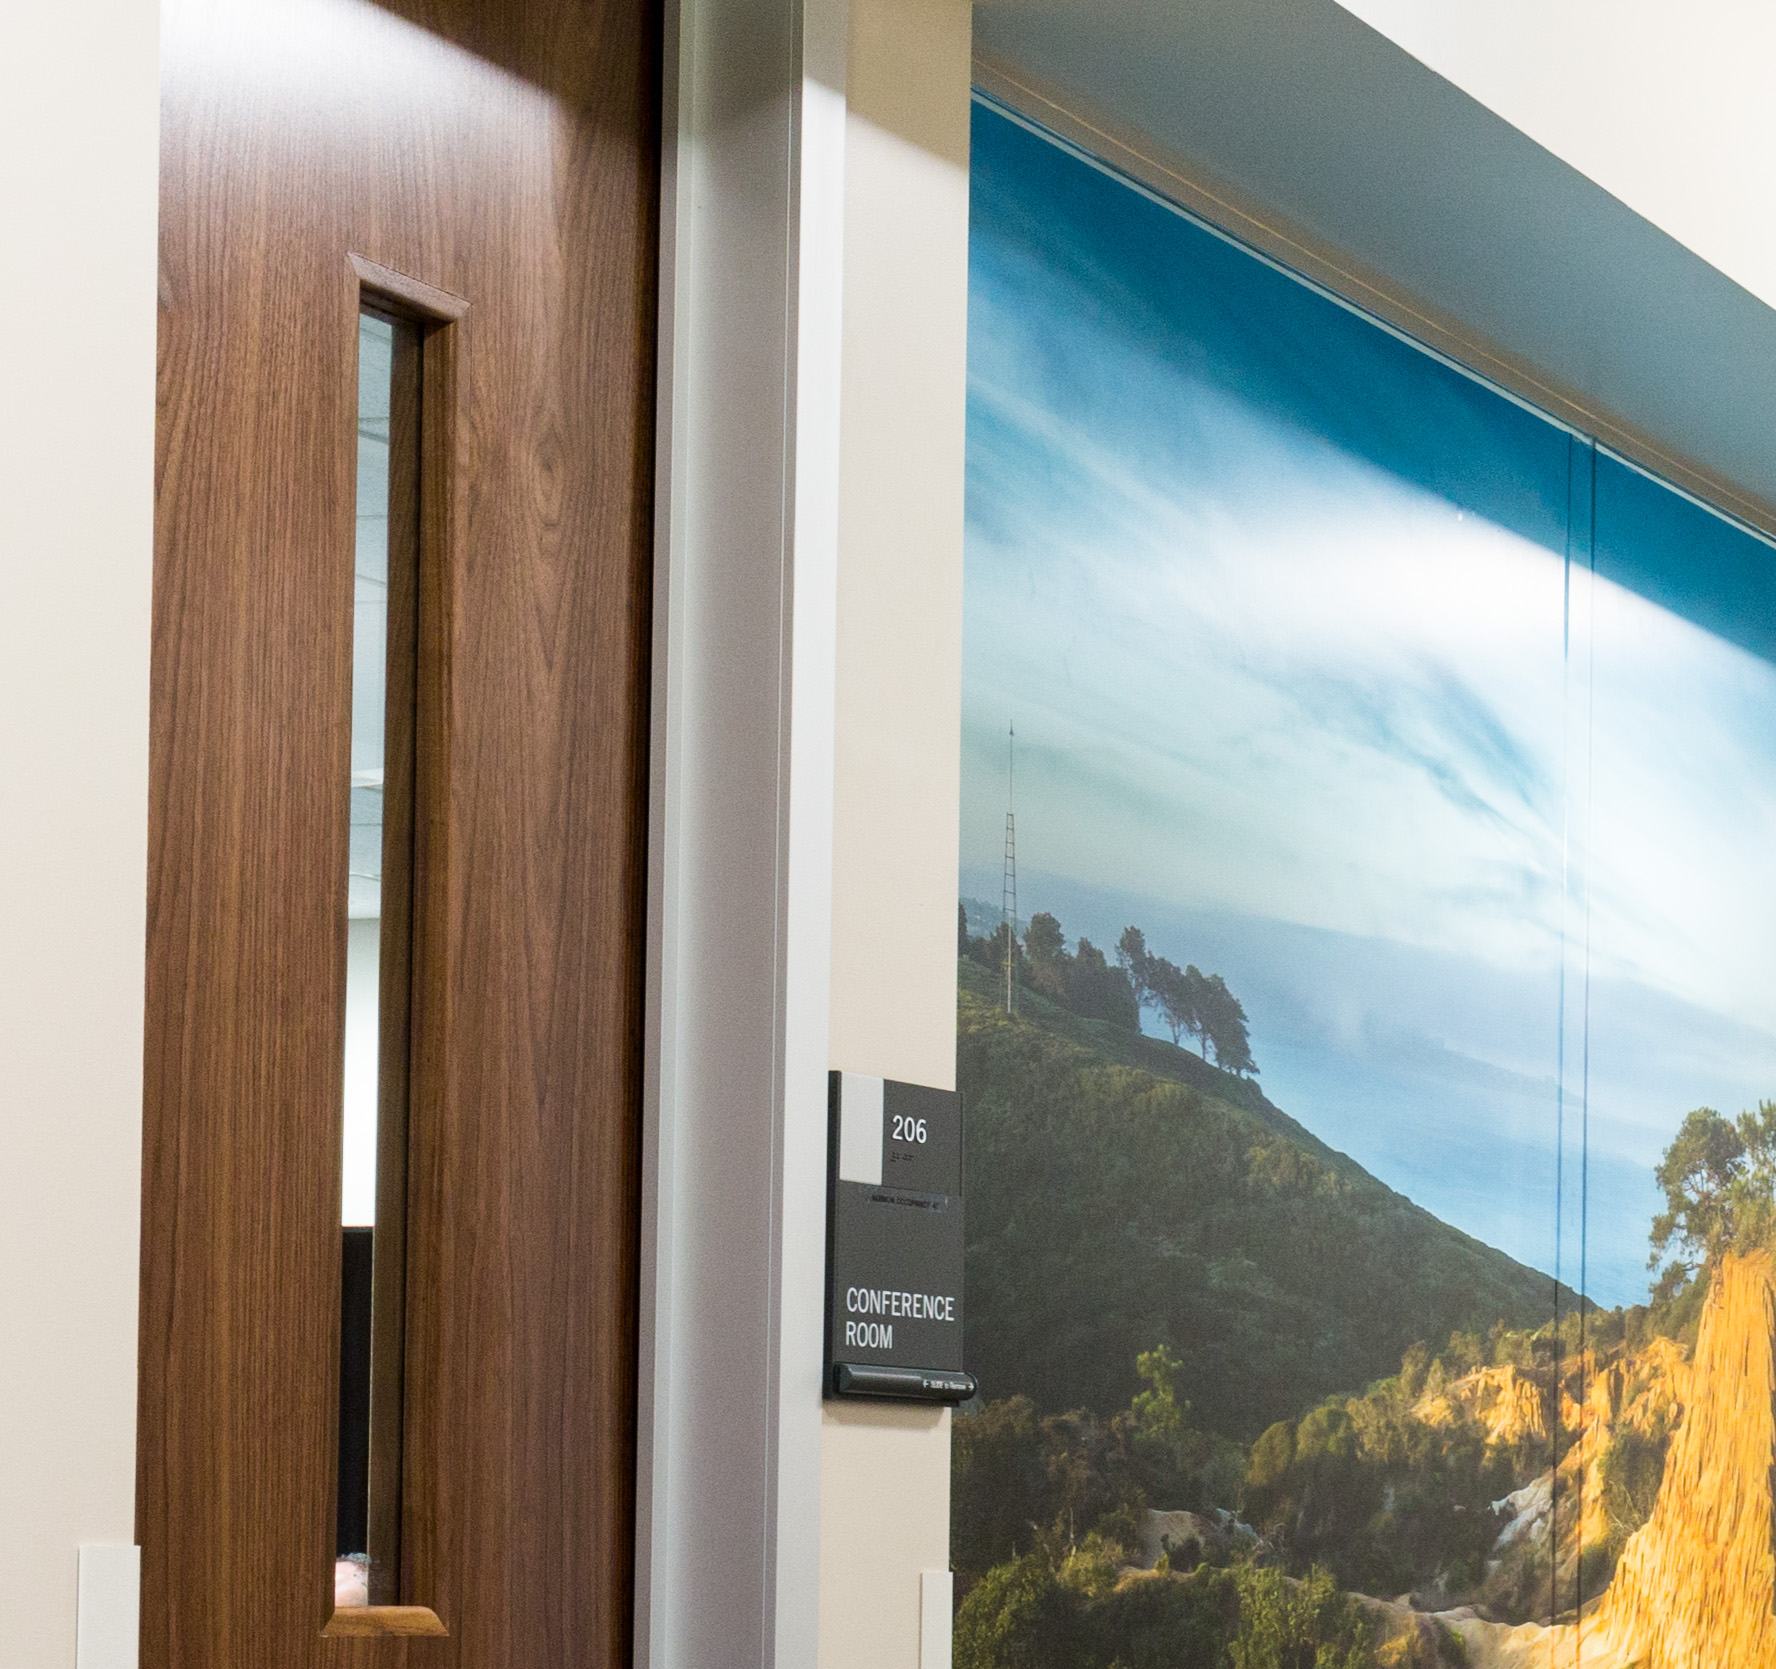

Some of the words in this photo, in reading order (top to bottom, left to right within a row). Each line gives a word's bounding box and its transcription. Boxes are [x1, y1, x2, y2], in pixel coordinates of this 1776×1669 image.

[892, 1115, 927, 1143] 206
[846, 1286, 955, 1321] CONFERENCE
[845, 1320, 893, 1349] ROOM
